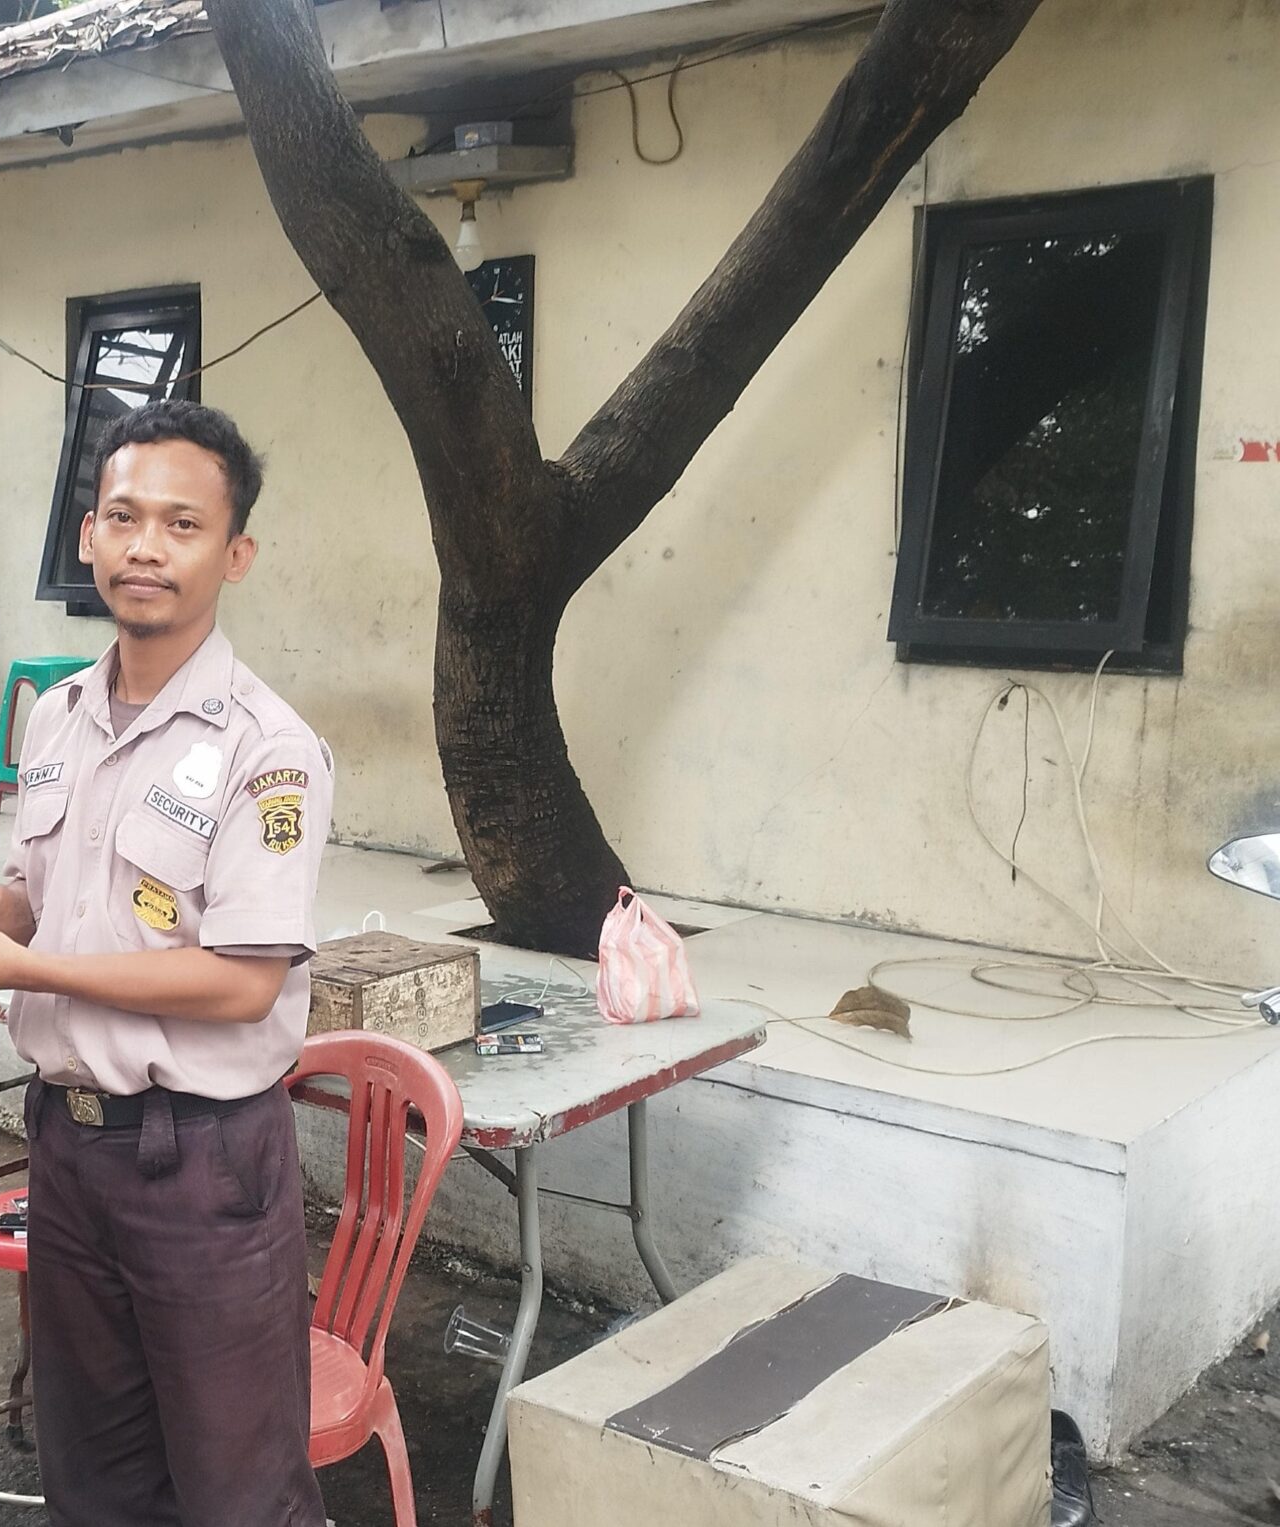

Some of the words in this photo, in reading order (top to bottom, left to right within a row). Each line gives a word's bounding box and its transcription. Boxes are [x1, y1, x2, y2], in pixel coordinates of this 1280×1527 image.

[498, 330, 523, 345] ATLAH
[252, 769, 306, 793] JAKARTA
[150, 791, 210, 831] SECURITY
[273, 821, 291, 834] 54
[268, 837, 296, 851] RUKO
